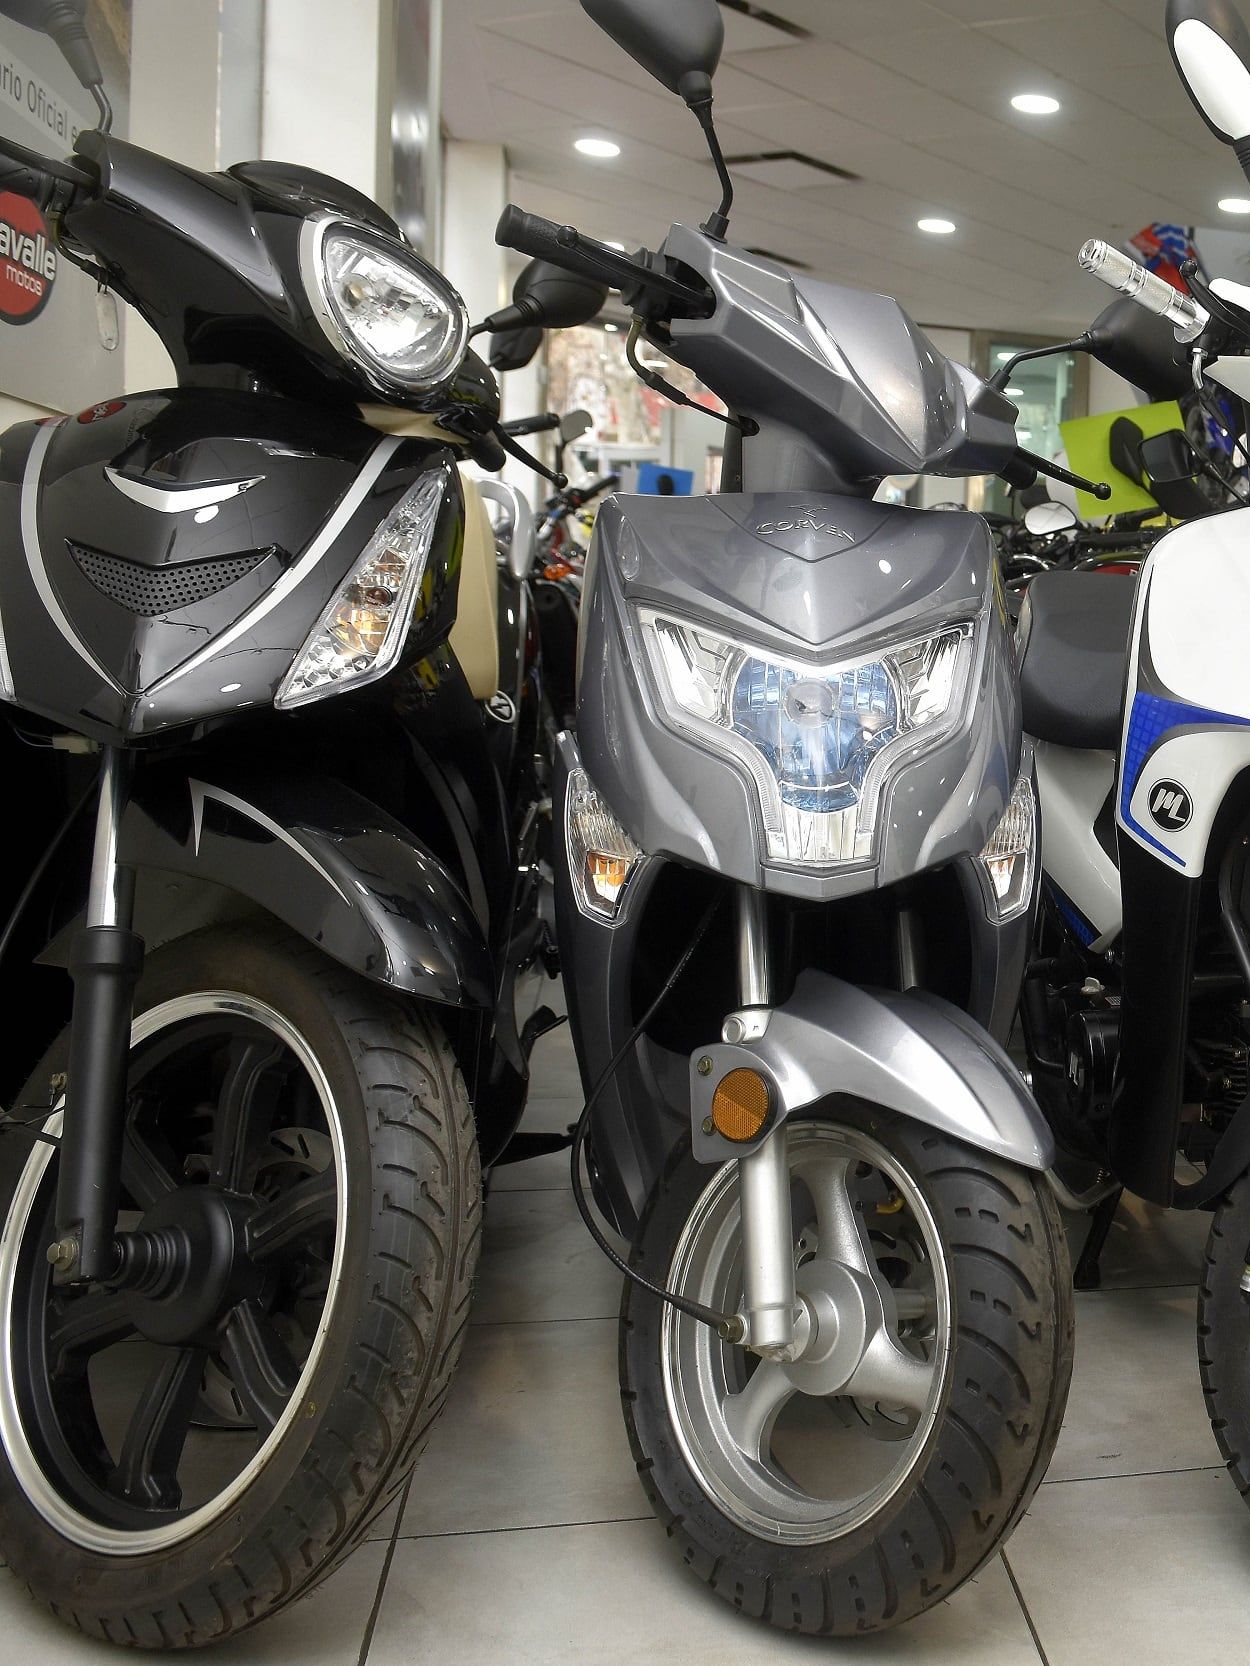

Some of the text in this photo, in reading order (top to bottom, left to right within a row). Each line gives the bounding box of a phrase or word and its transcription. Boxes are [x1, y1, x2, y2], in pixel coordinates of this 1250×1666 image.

[0, 63, 21, 102] rio
[27, 80, 68, 141] Oficial
[0, 222, 57, 281] avalle
[6, 264, 43, 297] motos
[756, 519, 856, 543] CORVEN
